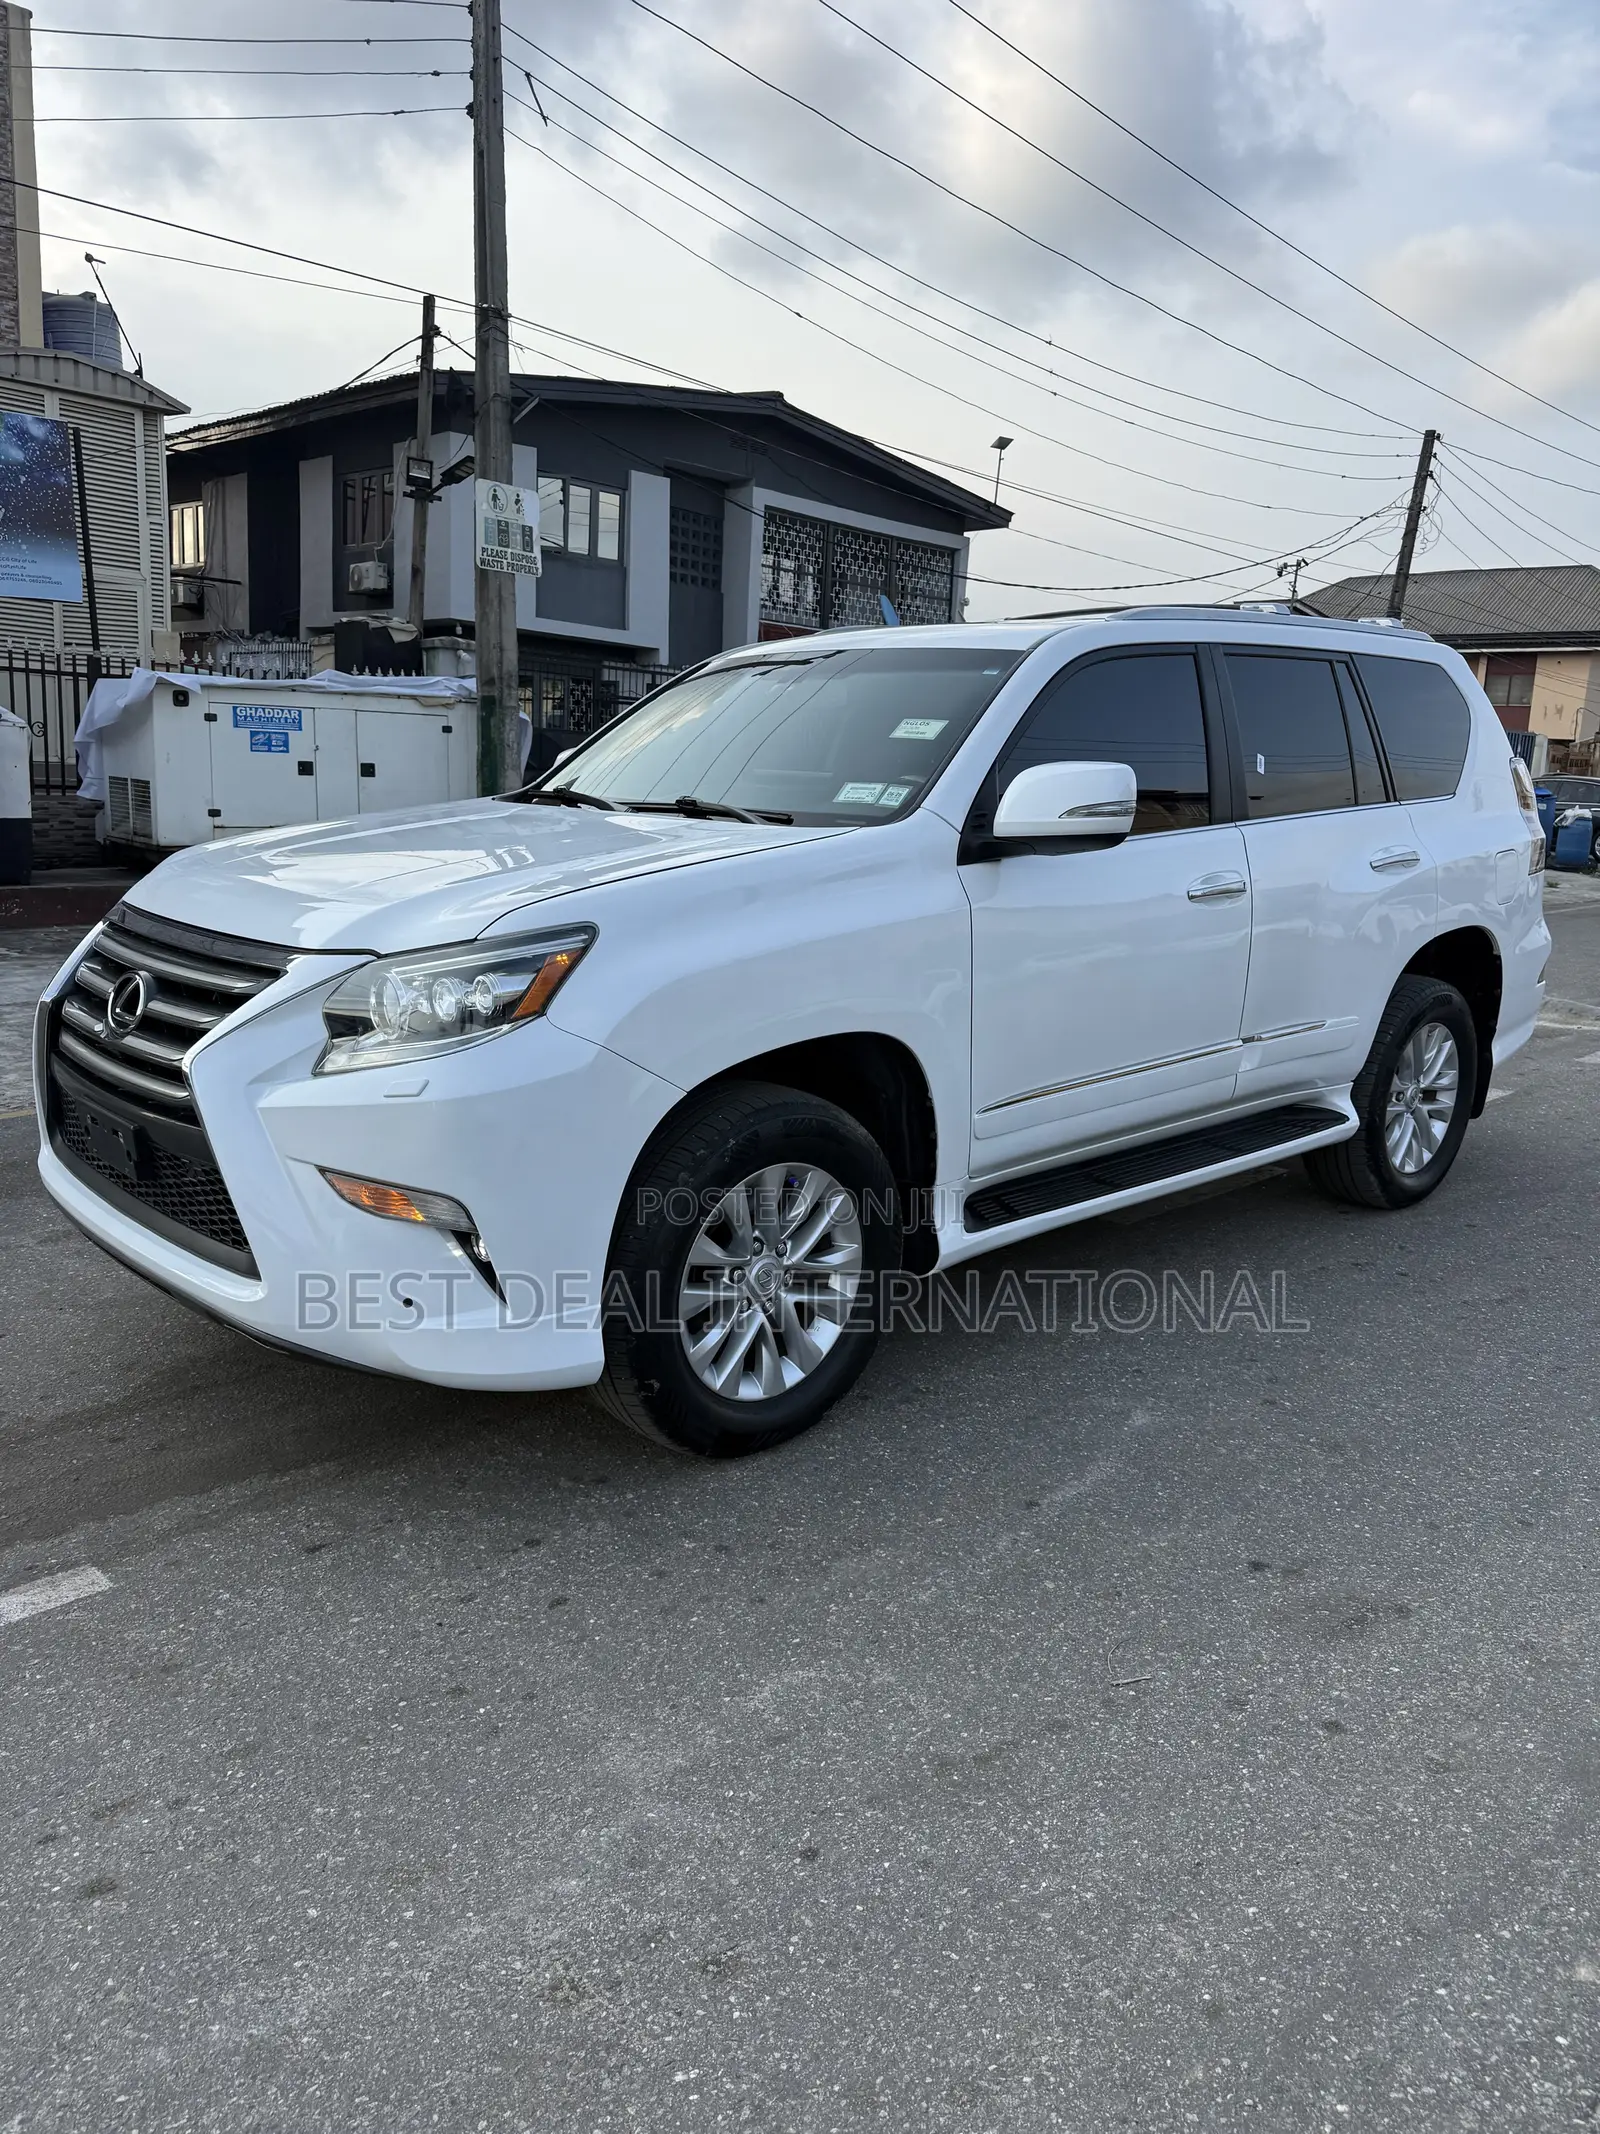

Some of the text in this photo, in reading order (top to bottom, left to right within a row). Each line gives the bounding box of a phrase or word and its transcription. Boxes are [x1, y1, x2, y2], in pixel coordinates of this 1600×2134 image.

[481, 547, 537, 565] PLEASE DISPOSE
[480, 557, 539, 576] WASTE PROPERLY
[236, 707, 299, 719] GHADDAR
[237, 716, 299, 724] MACHINERY
